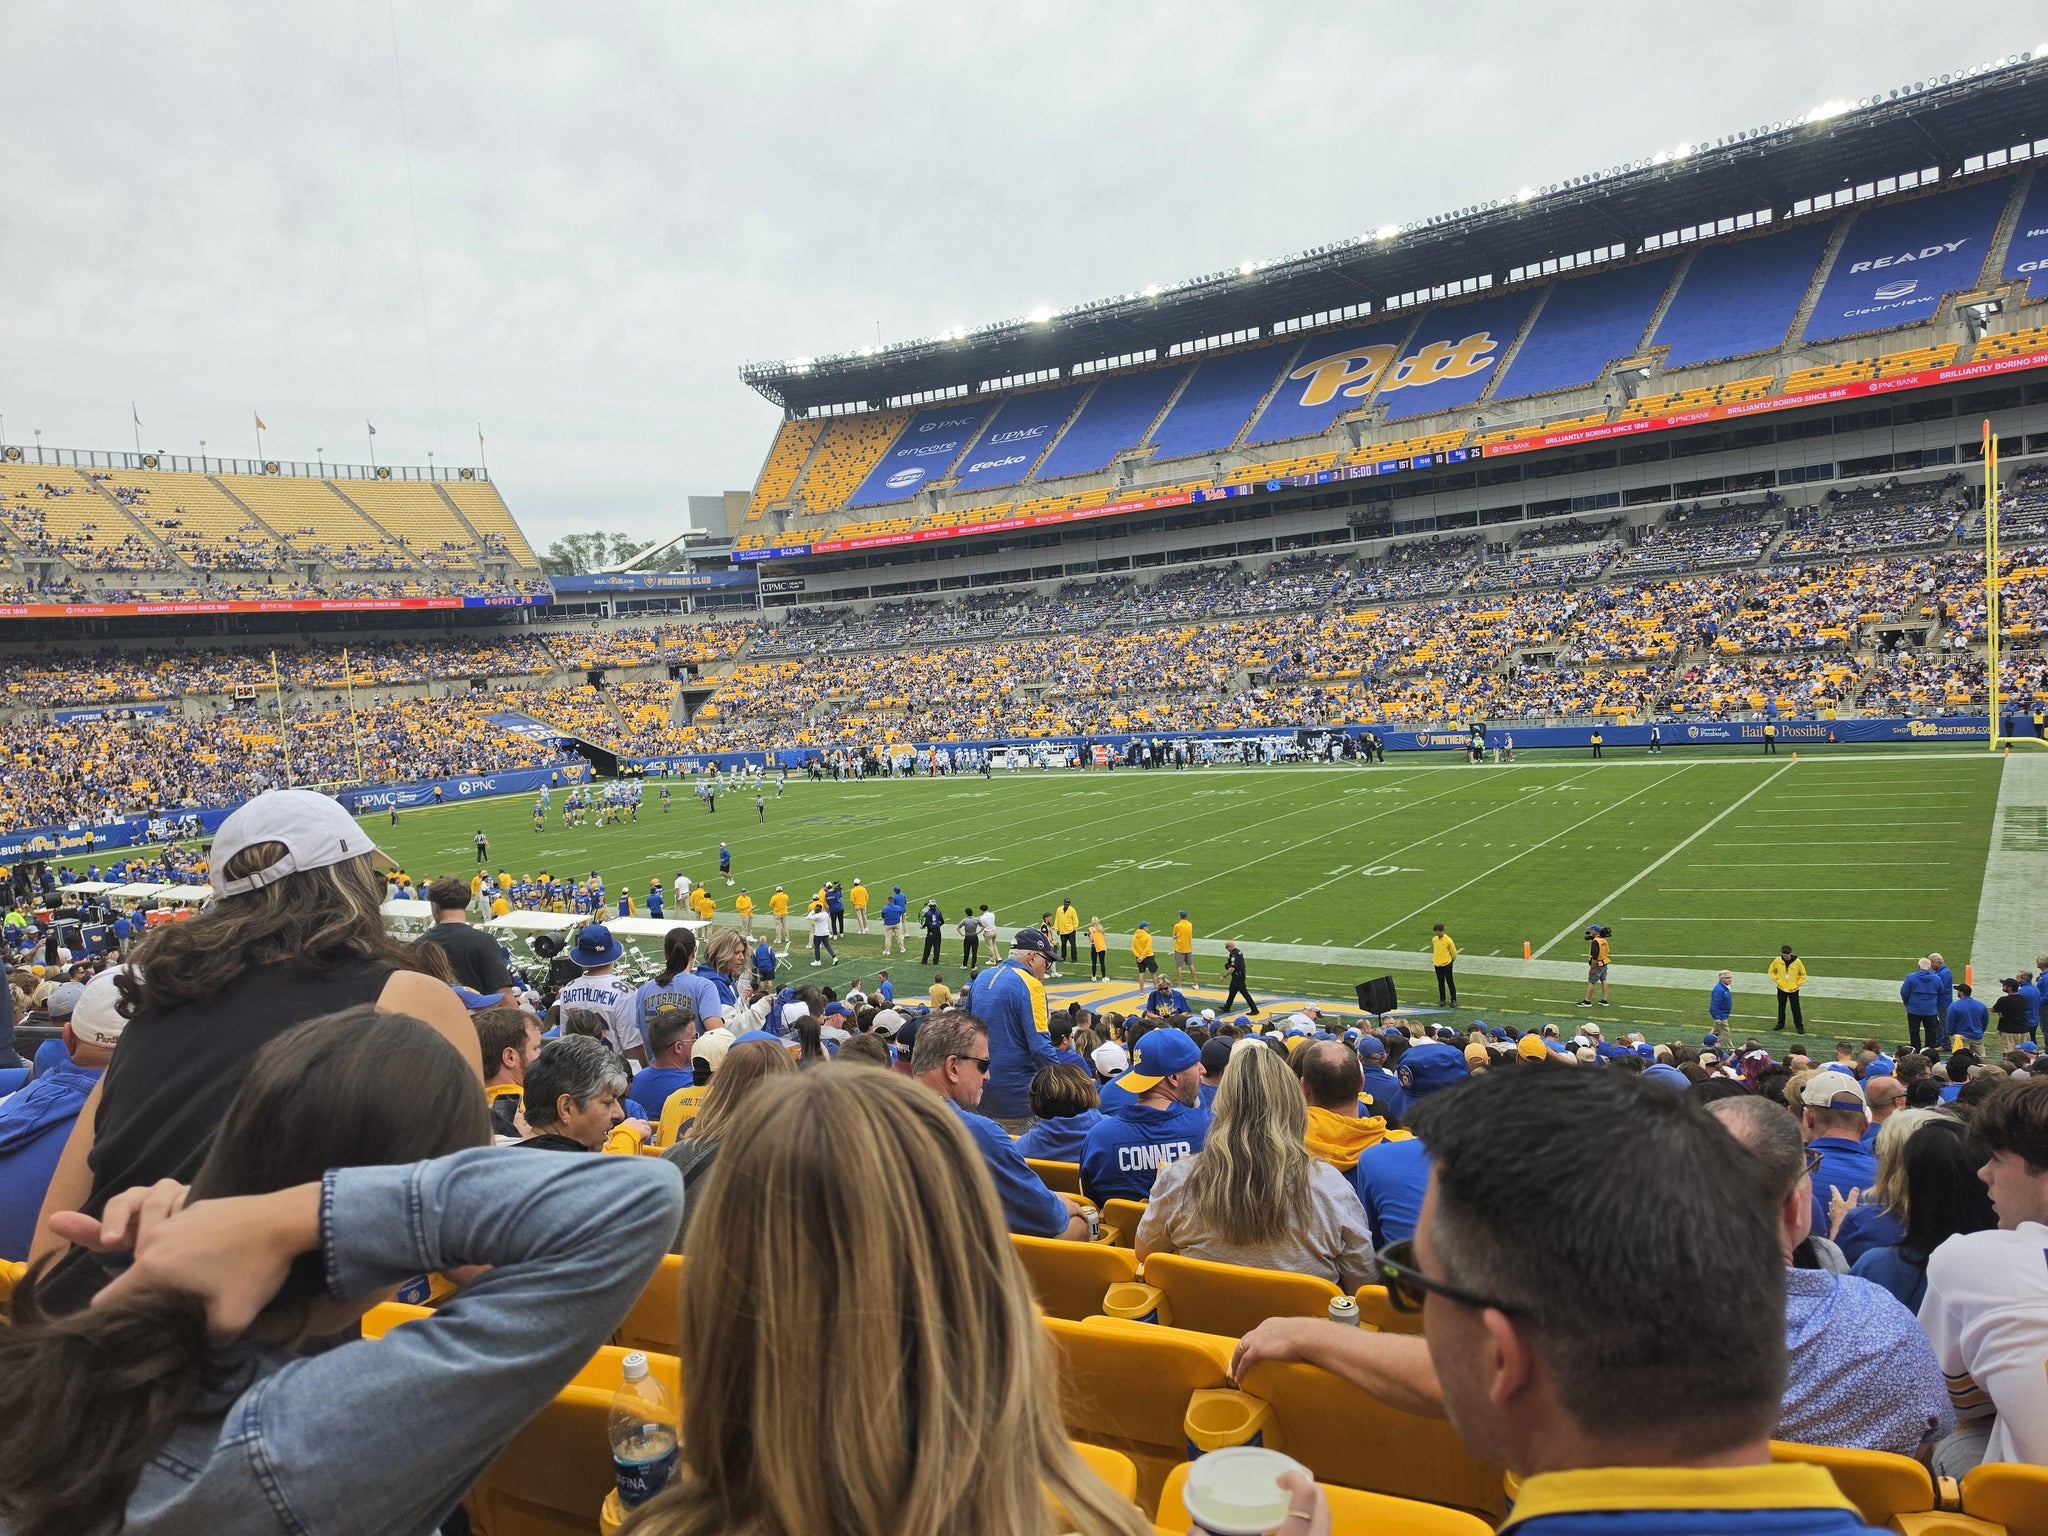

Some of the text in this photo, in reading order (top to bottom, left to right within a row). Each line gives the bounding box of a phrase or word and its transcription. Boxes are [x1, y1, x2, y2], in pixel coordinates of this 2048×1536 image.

[1850, 238, 1967, 274] READY
[1289, 331, 1498, 406] Pitt
[1939, 364, 1992, 380] BRILLIANTLY
[1994, 358, 2030, 370] BORING
[1728, 388, 1847, 415] BRILLIANTLY BORING SINCE 1865
[938, 417, 974, 430] PNC
[992, 426, 1048, 442] UPMC
[1545, 421, 1649, 445] BRILLIANTLY BORING SINCE 1865
[898, 441, 957, 456] encore
[1471, 448, 1480, 458] 25
[969, 456, 1026, 472] gecko
[1399, 460, 1409, 469] 1ST
[1436, 455, 1442, 463] 10
[1350, 466, 1372, 478] 15:00
[1304, 476, 1310, 485] 7
[1202, 488, 1227, 500] Pitt
[1240, 485, 1246, 495] 10
[692, 576, 711, 584] CLUB
[762, 582, 787, 592] UPMC
[1742, 726, 1763, 738] Hail
[1782, 725, 1827, 737] Possible
[1907, 721, 1938, 736] Pitt
[1431, 735, 1464, 744] PANTHER
[472, 780, 496, 791] PNC
[645, 992, 693, 1009] PITTSBURGH
[1118, 1141, 1191, 1172] CONNER
